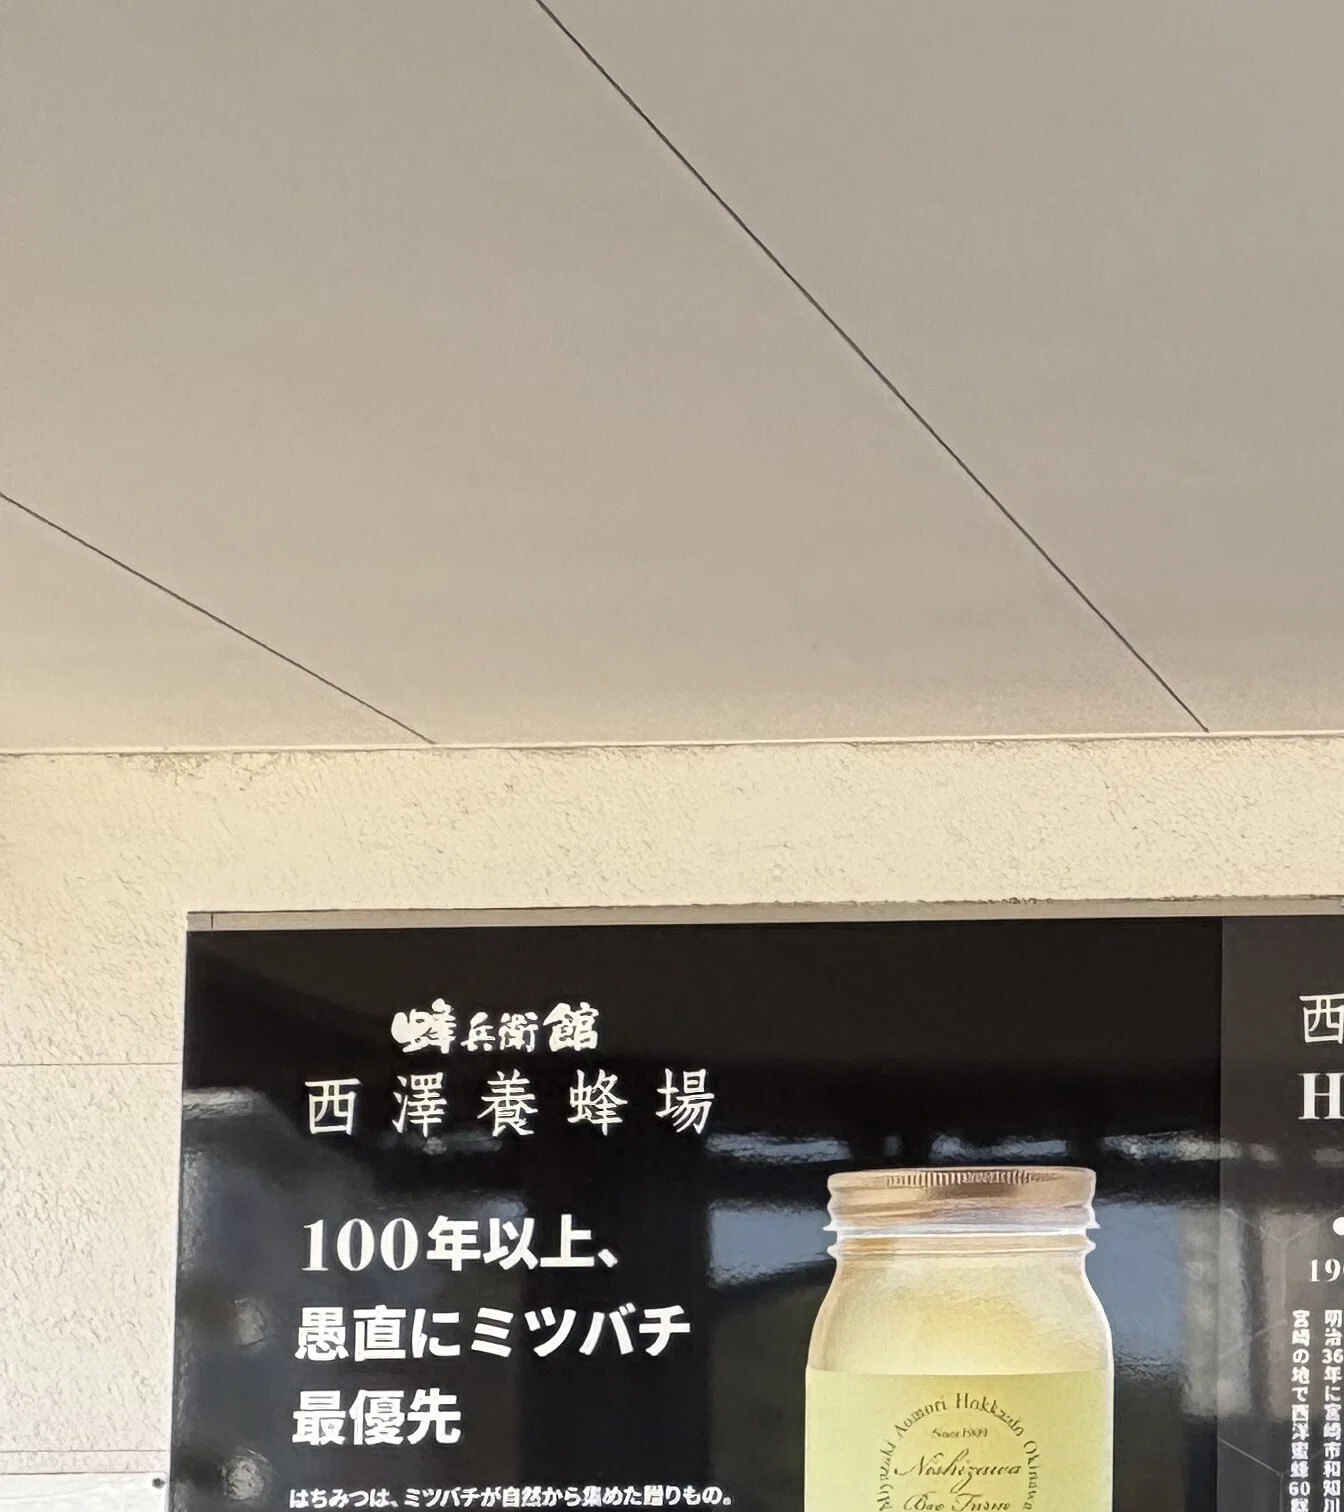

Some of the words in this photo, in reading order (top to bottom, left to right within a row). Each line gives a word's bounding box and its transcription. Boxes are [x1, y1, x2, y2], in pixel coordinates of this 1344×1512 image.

[390, 997, 599, 1054] 蜂兵衛館
[304, 1067, 714, 1137] 西澤養蜂場
[302, 1208, 618, 1271] 100年以上、
[294, 1301, 690, 1361] 愚直にミツバチ
[291, 1387, 461, 1445] 最優先
[289, 1484, 731, 1508] はちみつは、ミツバチが自然から集めた贈りもの。
